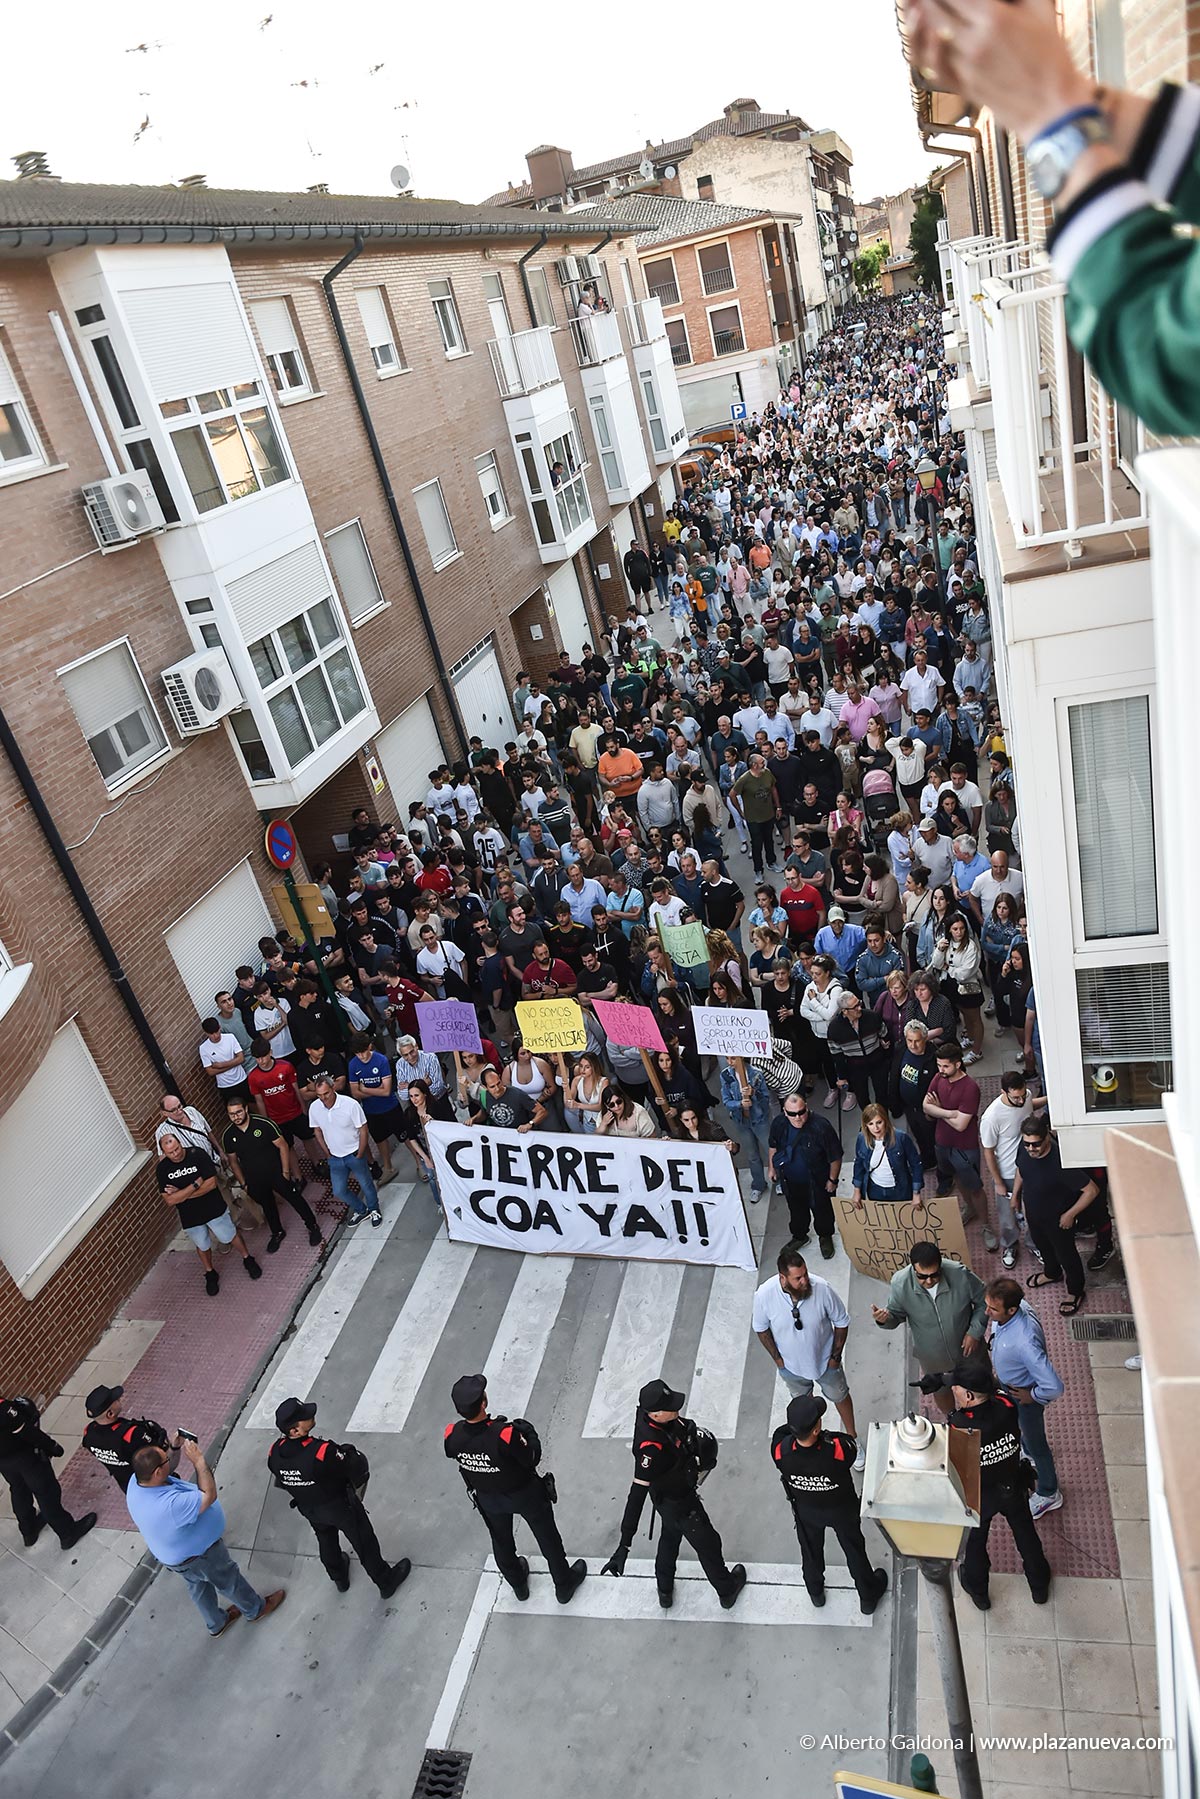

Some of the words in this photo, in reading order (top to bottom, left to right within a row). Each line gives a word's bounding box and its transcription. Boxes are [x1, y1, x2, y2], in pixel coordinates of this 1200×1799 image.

[733, 405, 743, 418] P
[523, 1007, 537, 1018] NO
[540, 1006, 572, 1017] SOMOS
[533, 1017, 575, 1031] RACISTAS
[701, 1013, 752, 1028] GOBIERNO
[432, 1034, 445, 1046] NO
[544, 1029, 587, 1048] REALISTAS
[738, 1029, 769, 1040] PUEBLO
[168, 1166, 198, 1179] adidas
[640, 1155, 724, 1193] DEL
[470, 1189, 563, 1235] COA
[864, 1228, 915, 1251] DEJEN
[980, 1433, 1016, 1455] POLICÍA
[457, 1452, 491, 1460] POLICÍA
[982, 1443, 1015, 1461] FORAL
[461, 1458, 491, 1467] FORAL
